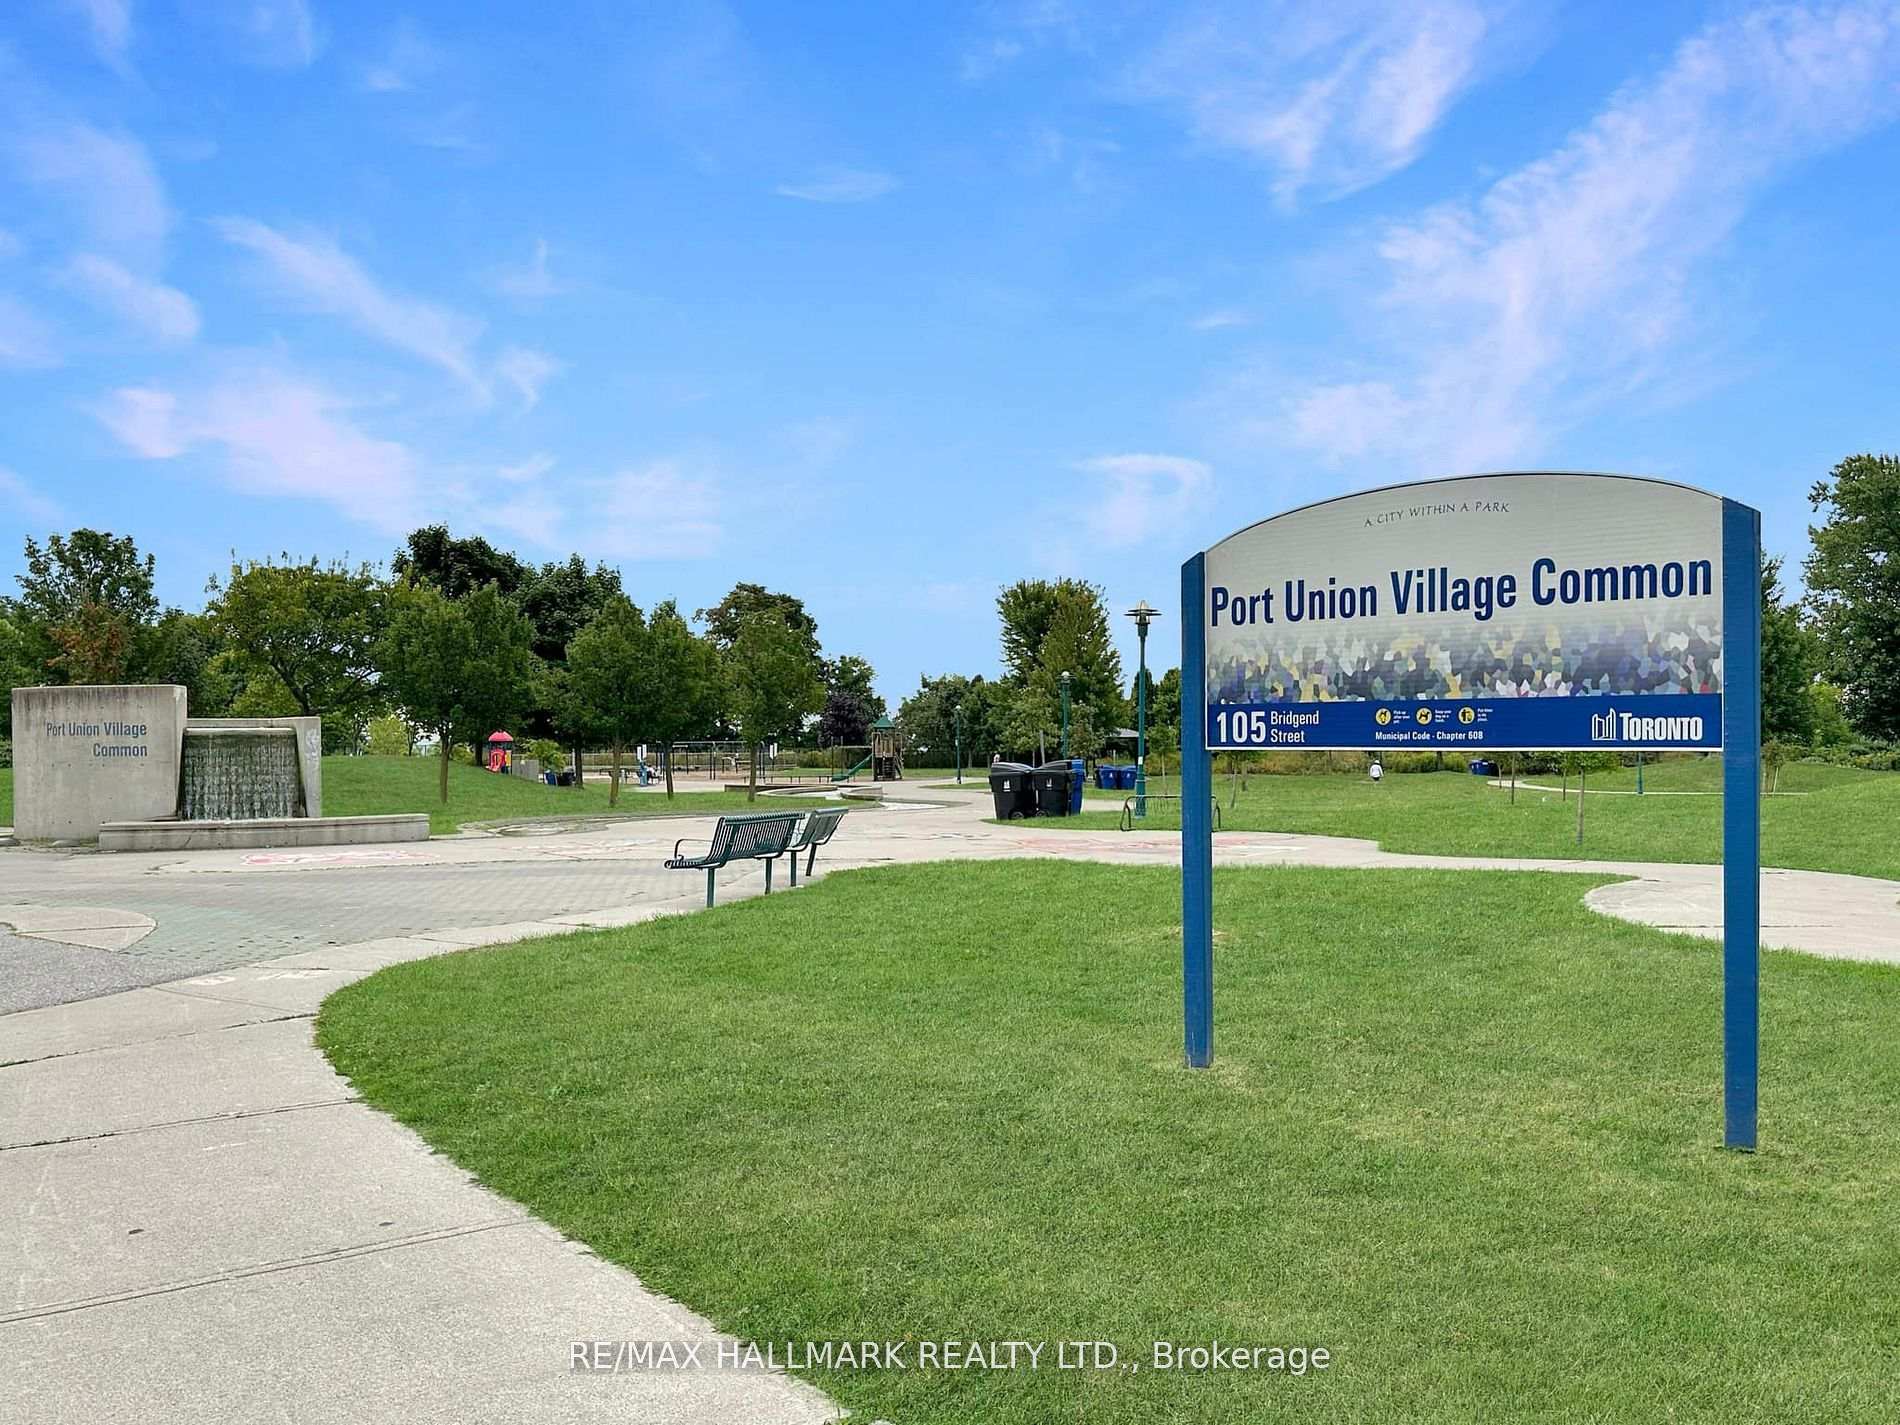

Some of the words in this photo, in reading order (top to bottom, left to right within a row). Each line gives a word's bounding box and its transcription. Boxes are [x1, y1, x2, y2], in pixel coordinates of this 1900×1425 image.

[1364, 519, 1373, 528] A
[1377, 510, 1404, 524] CITY
[1409, 503, 1456, 517] WITHIN
[1460, 502, 1470, 512] A
[1475, 501, 1510, 513] PARK
[1211, 586, 1274, 626] Port
[1285, 577, 1377, 622] Union
[1390, 567, 1517, 621] Village
[1532, 557, 1712, 605] Common
[1216, 711, 1266, 743] 105
[1270, 711, 1320, 727] Bridgend
[1619, 712, 1703, 741] TORONTO
[46, 722, 65, 737] Port
[68, 722, 100, 737] Union
[103, 722, 147, 738] Village
[1270, 731, 1305, 744] Street
[1375, 731, 1410, 741] Municipal
[1412, 731, 1430, 740] Code
[1436, 731, 1466, 741] Chapter
[93, 743, 148, 757] Common
